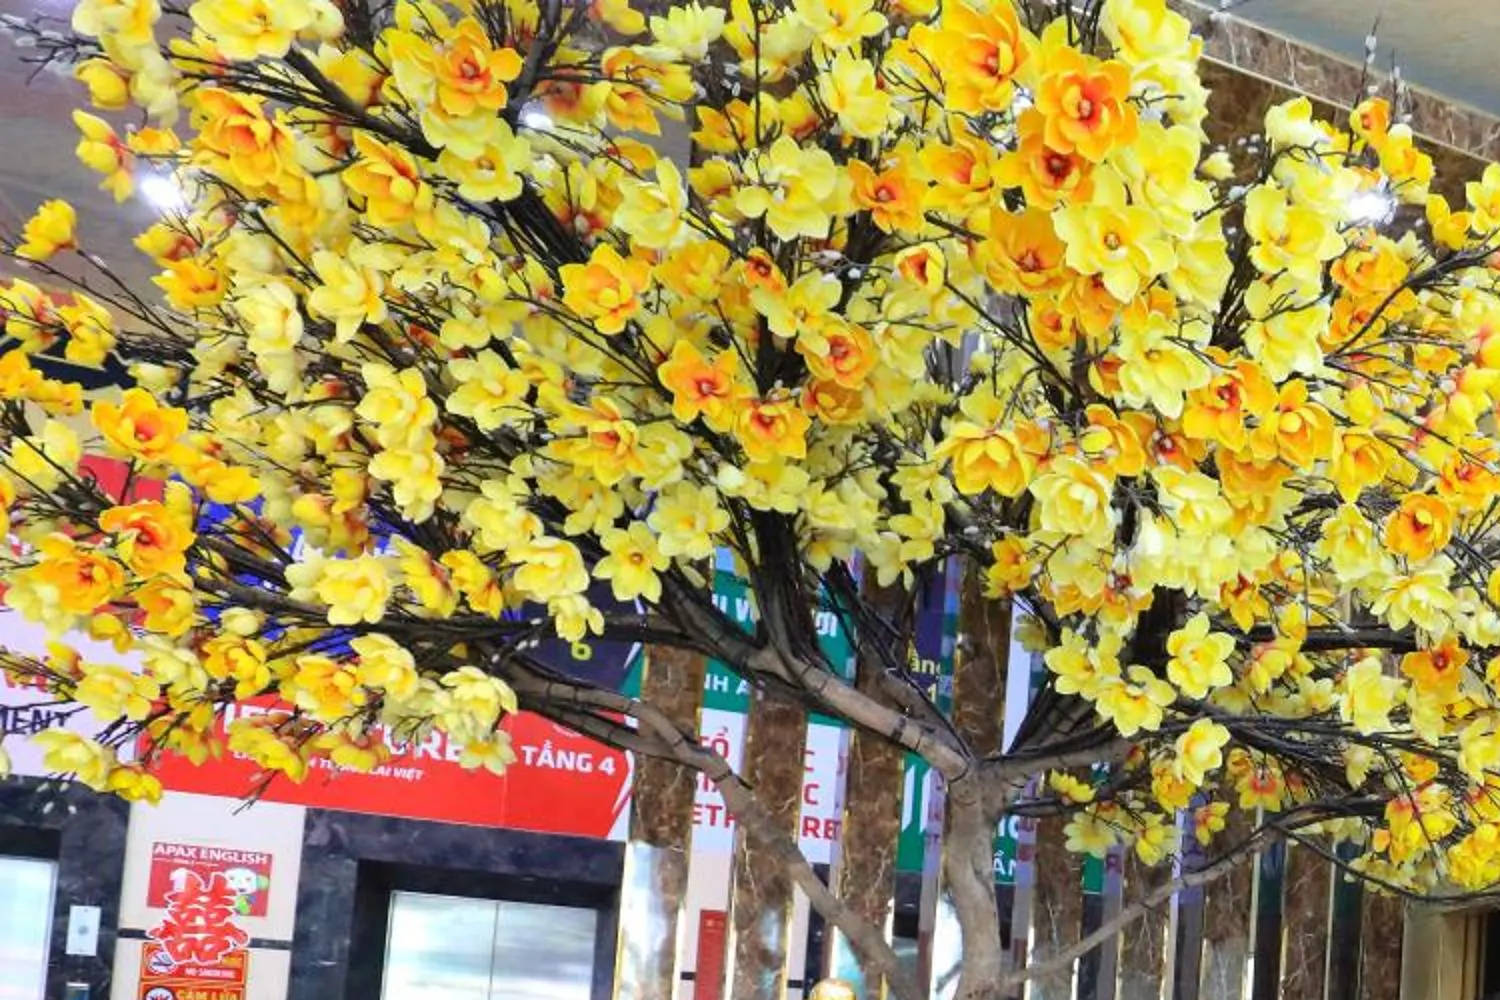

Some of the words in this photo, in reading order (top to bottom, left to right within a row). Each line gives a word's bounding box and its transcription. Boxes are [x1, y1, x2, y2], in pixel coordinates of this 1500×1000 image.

[598, 756, 616, 776] 4
[153, 843, 198, 860] APAX
[200, 846, 269, 866] ENGLISH
